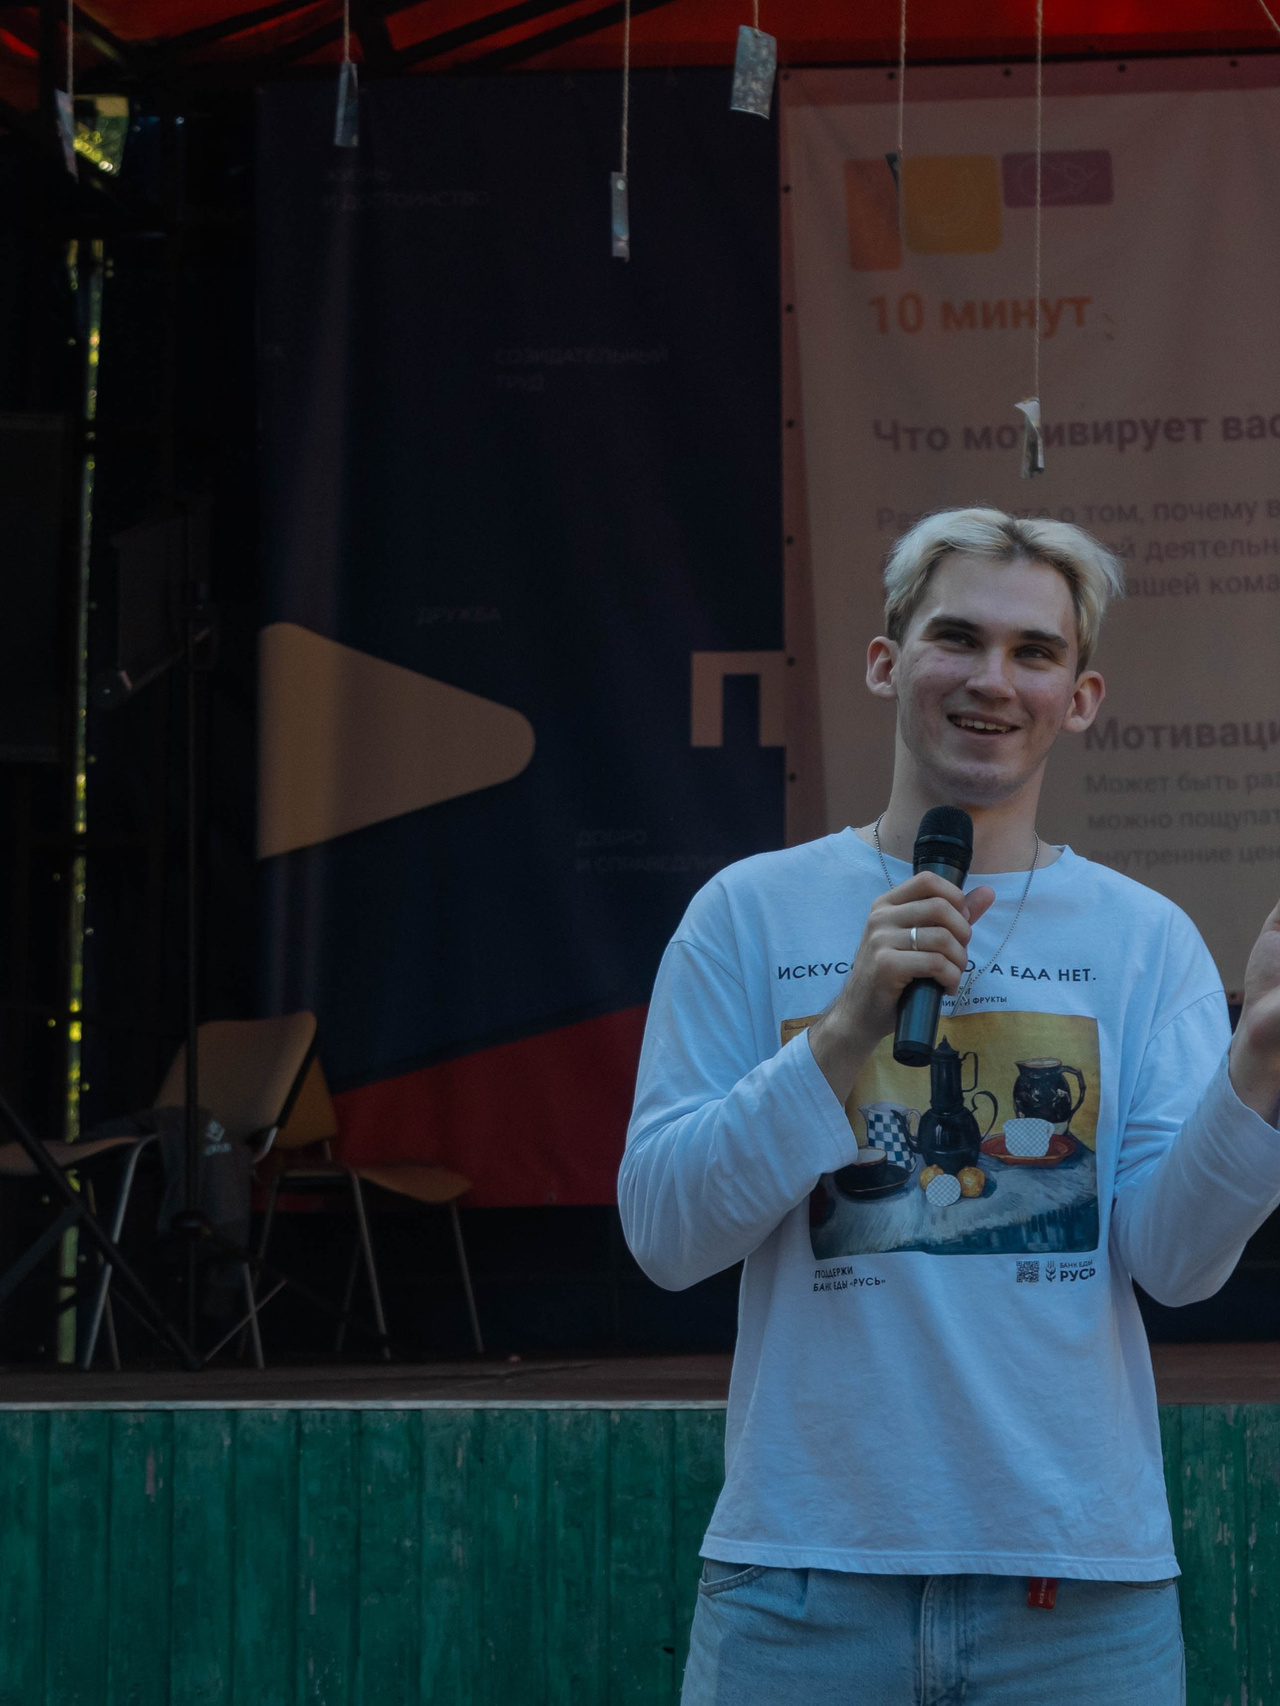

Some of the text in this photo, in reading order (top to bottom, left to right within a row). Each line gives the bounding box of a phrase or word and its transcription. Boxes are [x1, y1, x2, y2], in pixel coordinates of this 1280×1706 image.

[867, 291, 1094, 340] 10 минут
[872, 418, 952, 453] Что
[963, 416, 1209, 453] моивирует
[1082, 503, 1145, 528] том,
[1153, 502, 1259, 530] почему
[1085, 773, 1169, 794] Может
[1177, 771, 1238, 791] быть
[1087, 810, 1173, 831] можно
[990, 963, 1004, 975] А
[1010, 965, 1051, 981] ЕДА
[1058, 968, 1097, 982] НЕТ.
[972, 996, 1008, 1005] ФРУКТЫ
[1078, 1259, 1094, 1267] ЕДЫ
